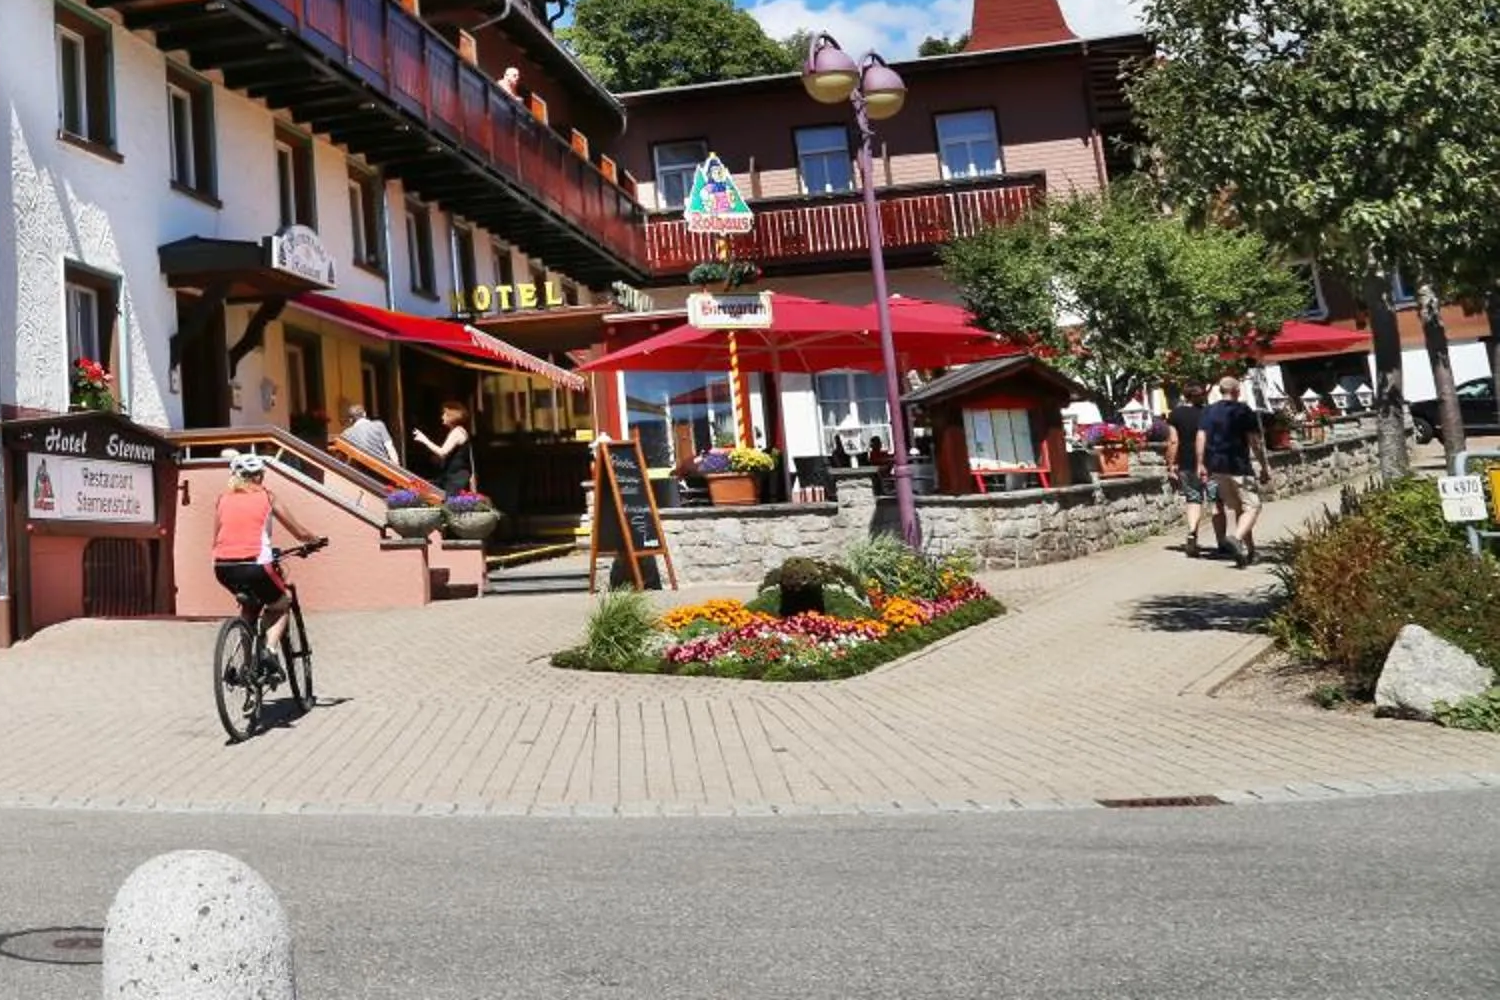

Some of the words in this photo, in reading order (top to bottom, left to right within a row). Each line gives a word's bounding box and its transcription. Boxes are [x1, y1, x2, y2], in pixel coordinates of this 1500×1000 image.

[449, 281, 564, 313] HOTEL
[45, 427, 88, 453] Hotel
[105, 434, 156, 462] Sternen
[81, 467, 134, 490] Restaurant
